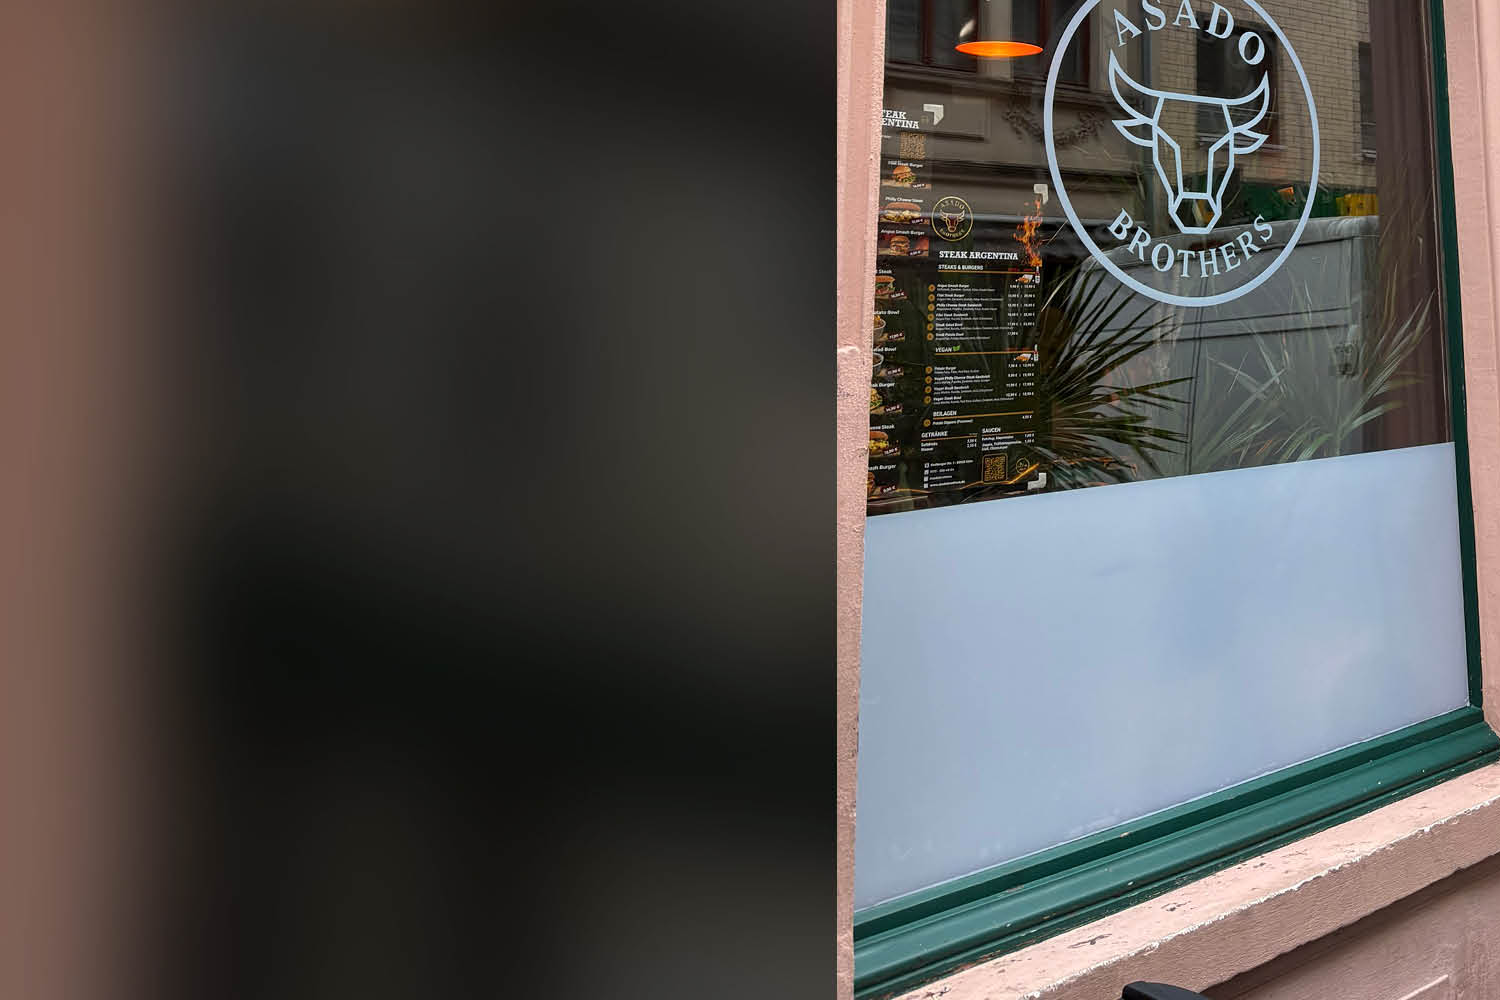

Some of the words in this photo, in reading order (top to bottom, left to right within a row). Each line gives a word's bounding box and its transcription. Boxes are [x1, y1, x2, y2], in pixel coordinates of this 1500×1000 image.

[882, 118, 919, 129] ENTINA
[1107, 208, 1273, 278] BROTHERS
[969, 252, 1018, 260] ARGENTINA
